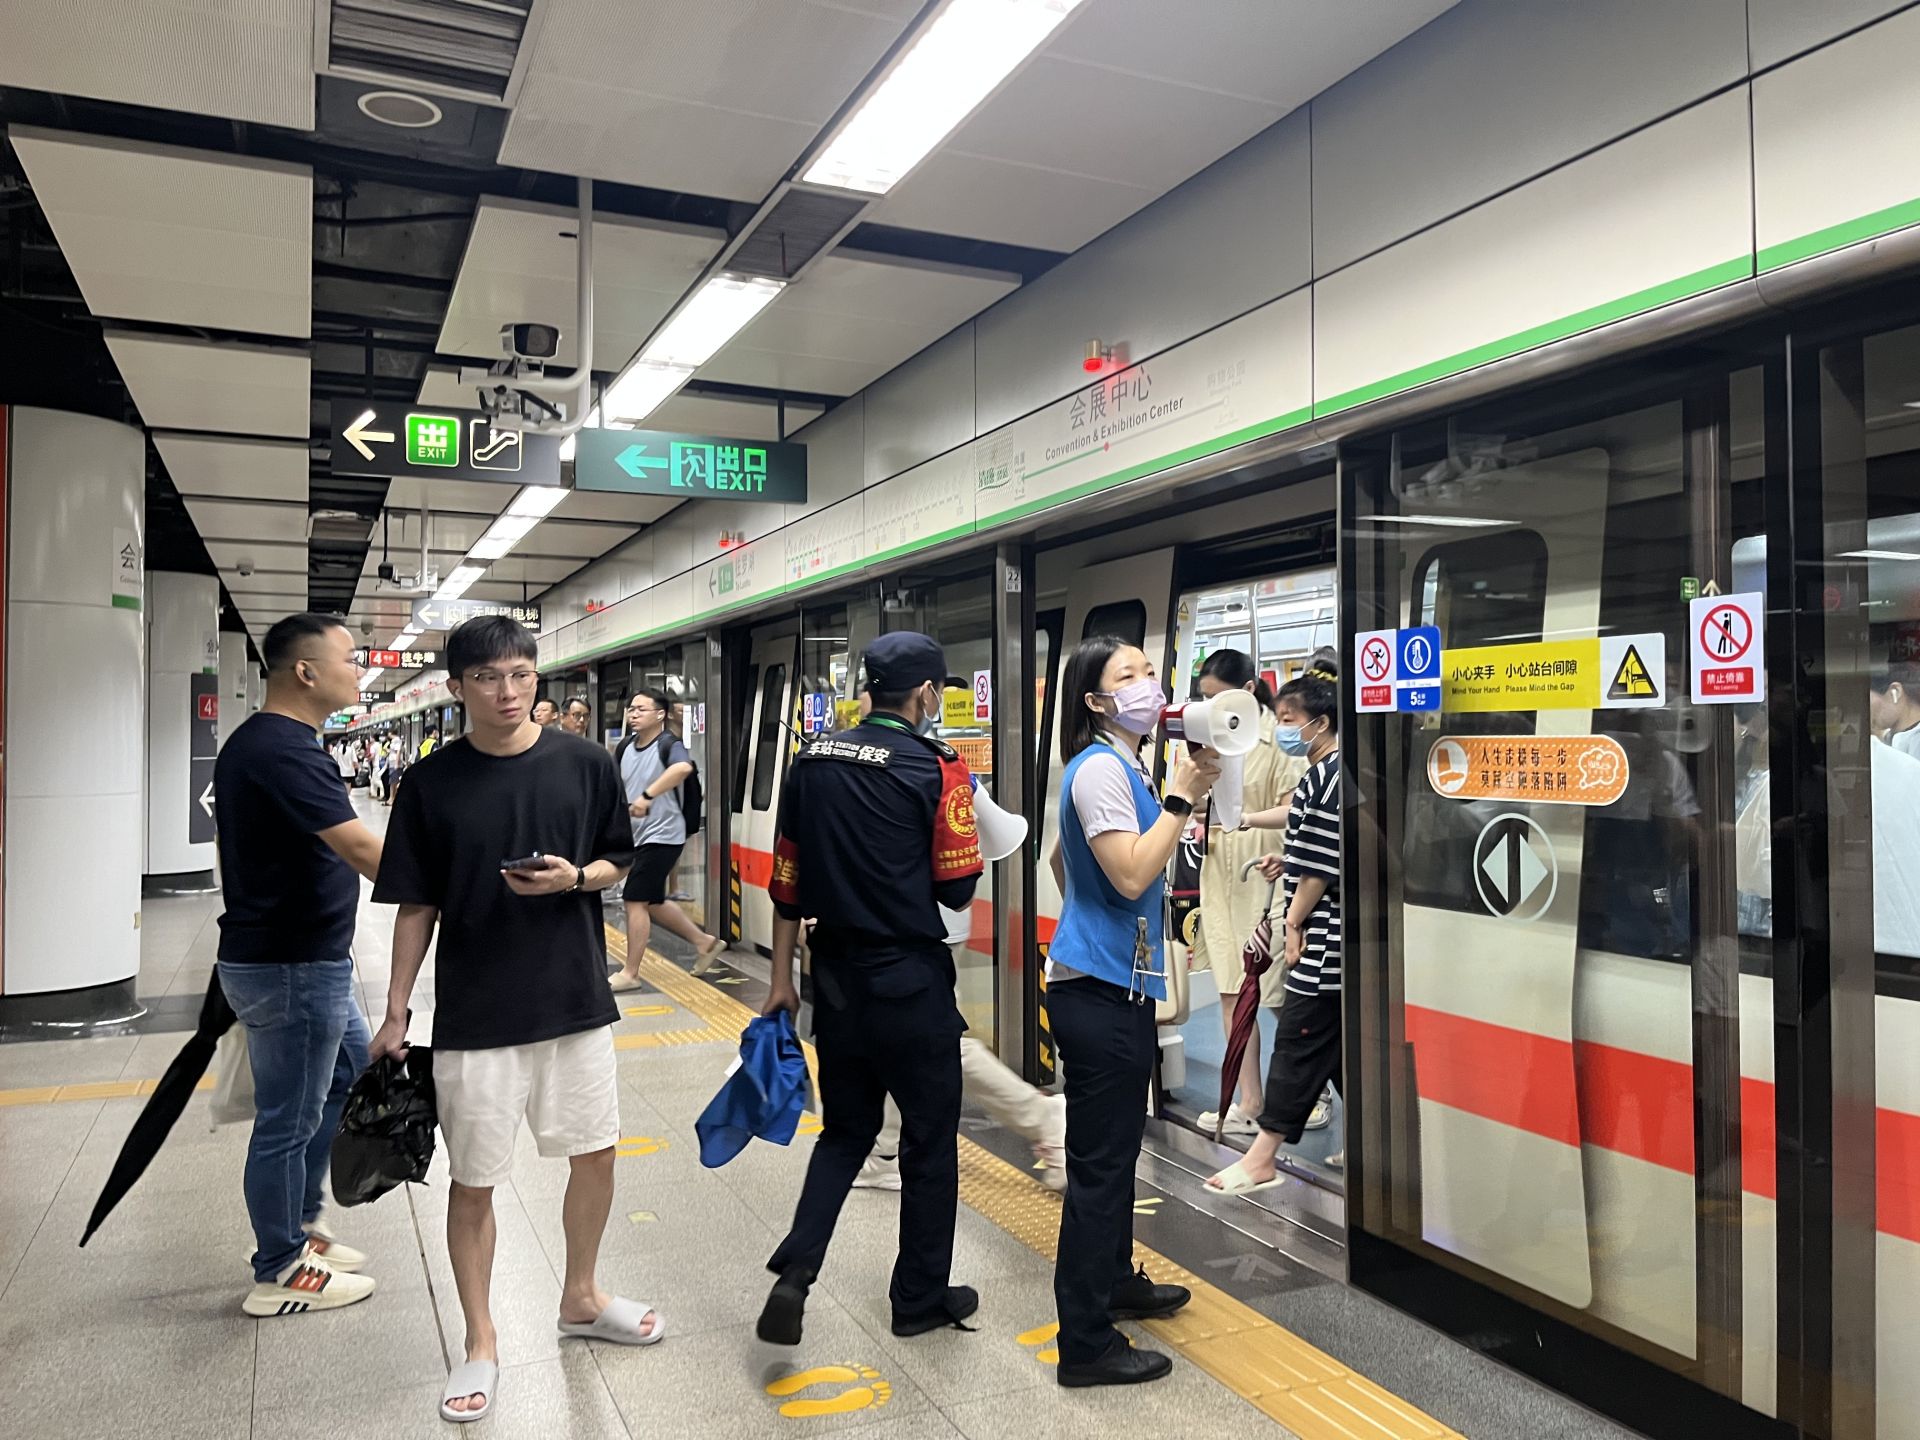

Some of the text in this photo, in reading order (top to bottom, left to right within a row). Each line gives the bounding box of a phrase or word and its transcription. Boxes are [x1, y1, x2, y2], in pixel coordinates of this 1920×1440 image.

[1069, 365, 1152, 431] 会展中心
[1045, 433, 1091, 462] Convention
[1092, 431, 1099, 442] &
[1101, 411, 1148, 440] Exhibition
[1149, 397, 1184, 421] Center
[417, 446, 447, 460] EXIT
[716, 446, 767, 474] 出口
[716, 471, 767, 493] EXIT
[372, 651, 383, 665] 4
[1452, 659, 1578, 681] 小心夹手 小心站台间隙
[1706, 671, 1745, 685] 禁止倚靠
[1452, 687, 1467, 695] Mind
[1505, 684, 1528, 692] Please
[1547, 683, 1559, 691] the
[1560, 682, 1575, 691] Gap
[1410, 691, 1418, 706] 5
[807, 741, 835, 756] 车站
[857, 745, 890, 764] 保安
